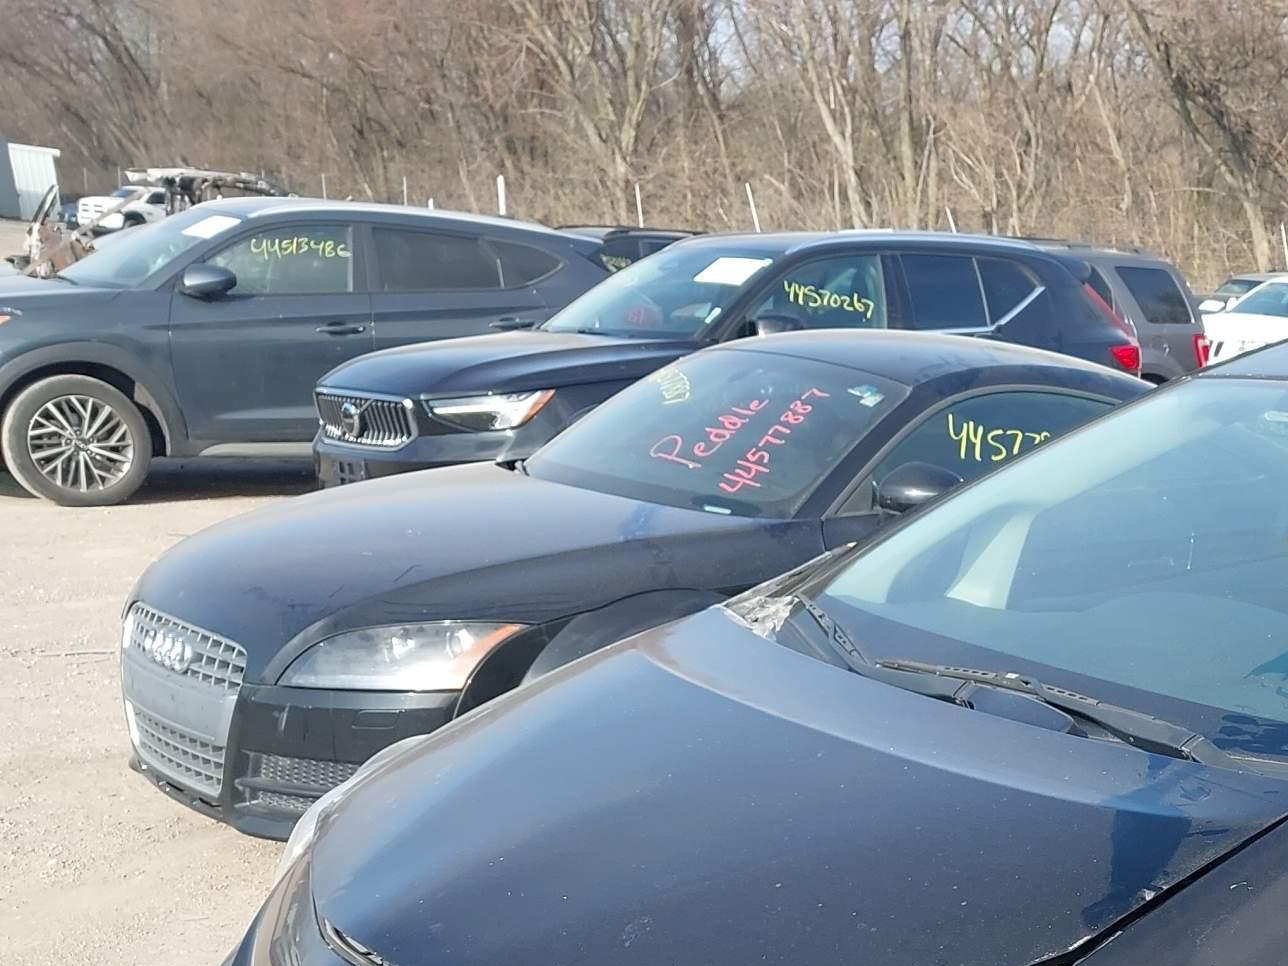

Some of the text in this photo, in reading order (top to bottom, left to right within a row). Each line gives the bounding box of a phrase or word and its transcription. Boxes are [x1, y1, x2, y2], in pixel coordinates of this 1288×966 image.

[251, 236, 352, 260] 44513486
[783, 280, 875, 319] 44570267
[650, 399, 768, 468] Peddle
[719, 388, 830, 493] 44577887
